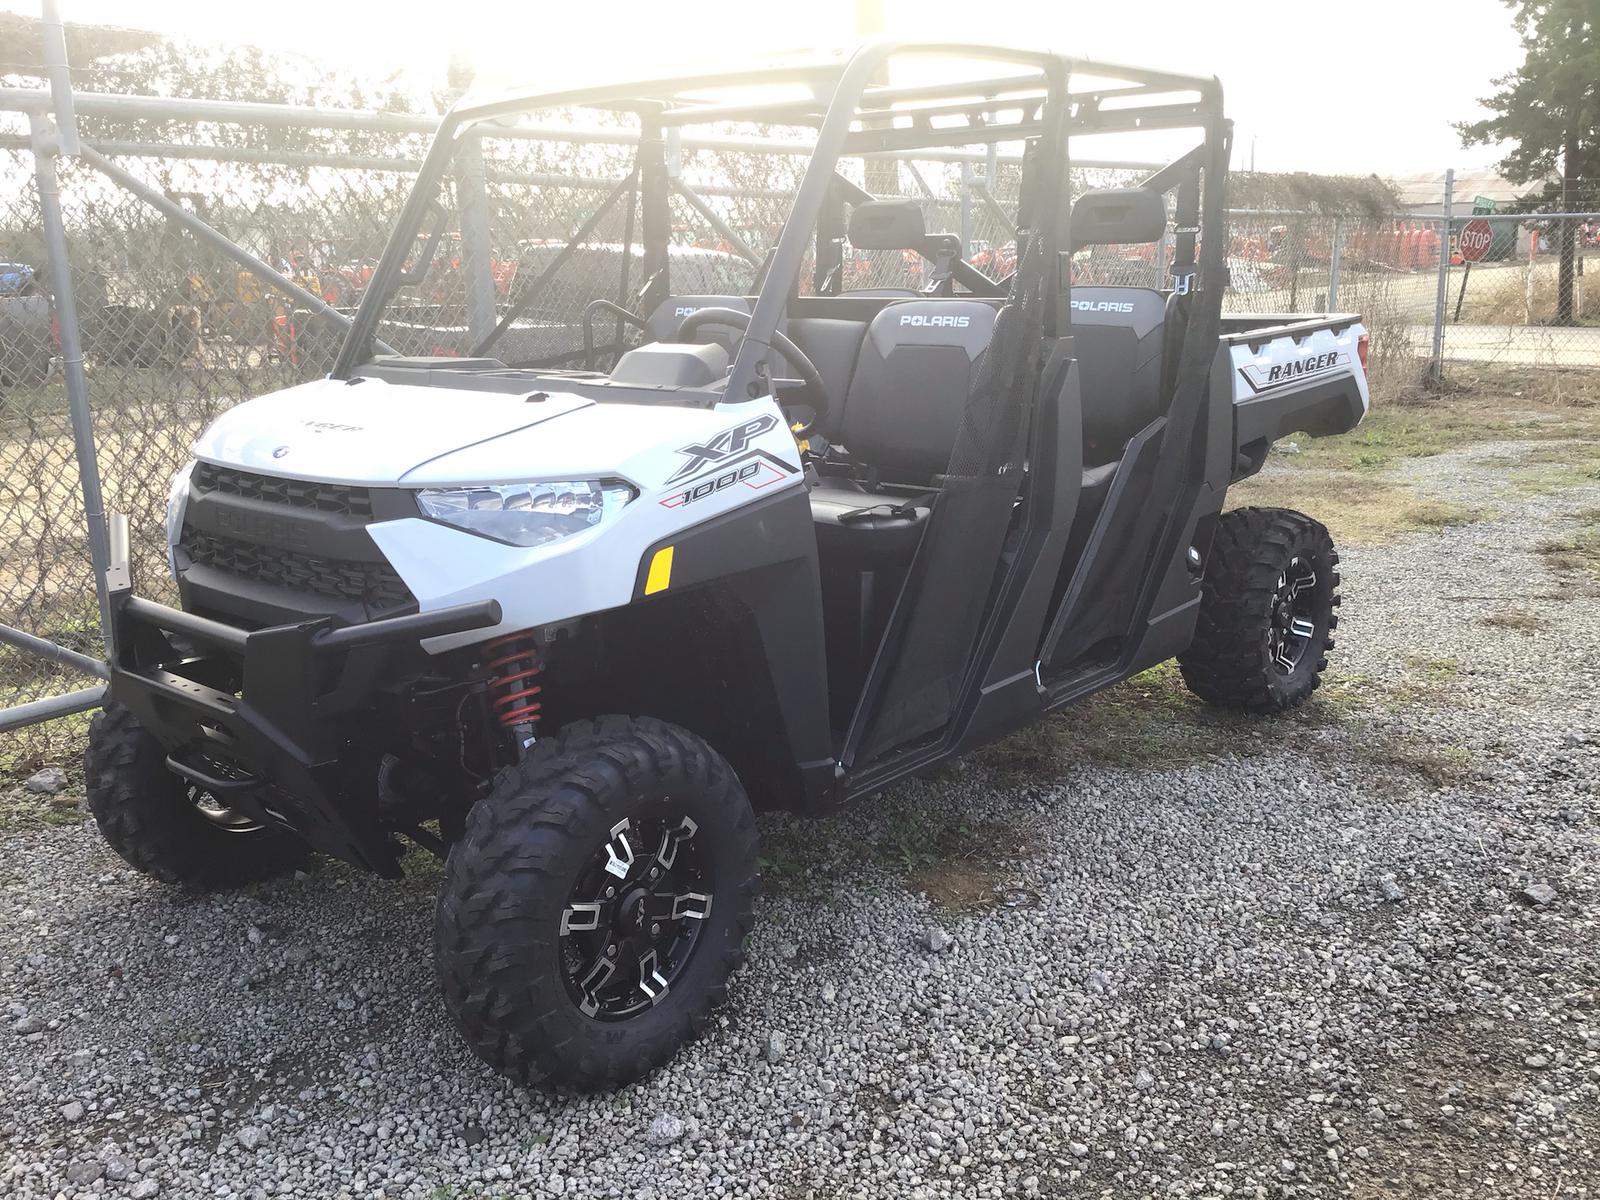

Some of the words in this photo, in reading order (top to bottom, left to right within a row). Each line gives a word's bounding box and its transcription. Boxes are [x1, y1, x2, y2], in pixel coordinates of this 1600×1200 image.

[1462, 230, 1491, 250] STOP
[1070, 300, 1135, 313] POLARIS
[900, 315, 971, 328] POLARIS
[1268, 351, 1339, 383] RANGER
[663, 413, 780, 486] XP
[682, 460, 762, 507] 1000
